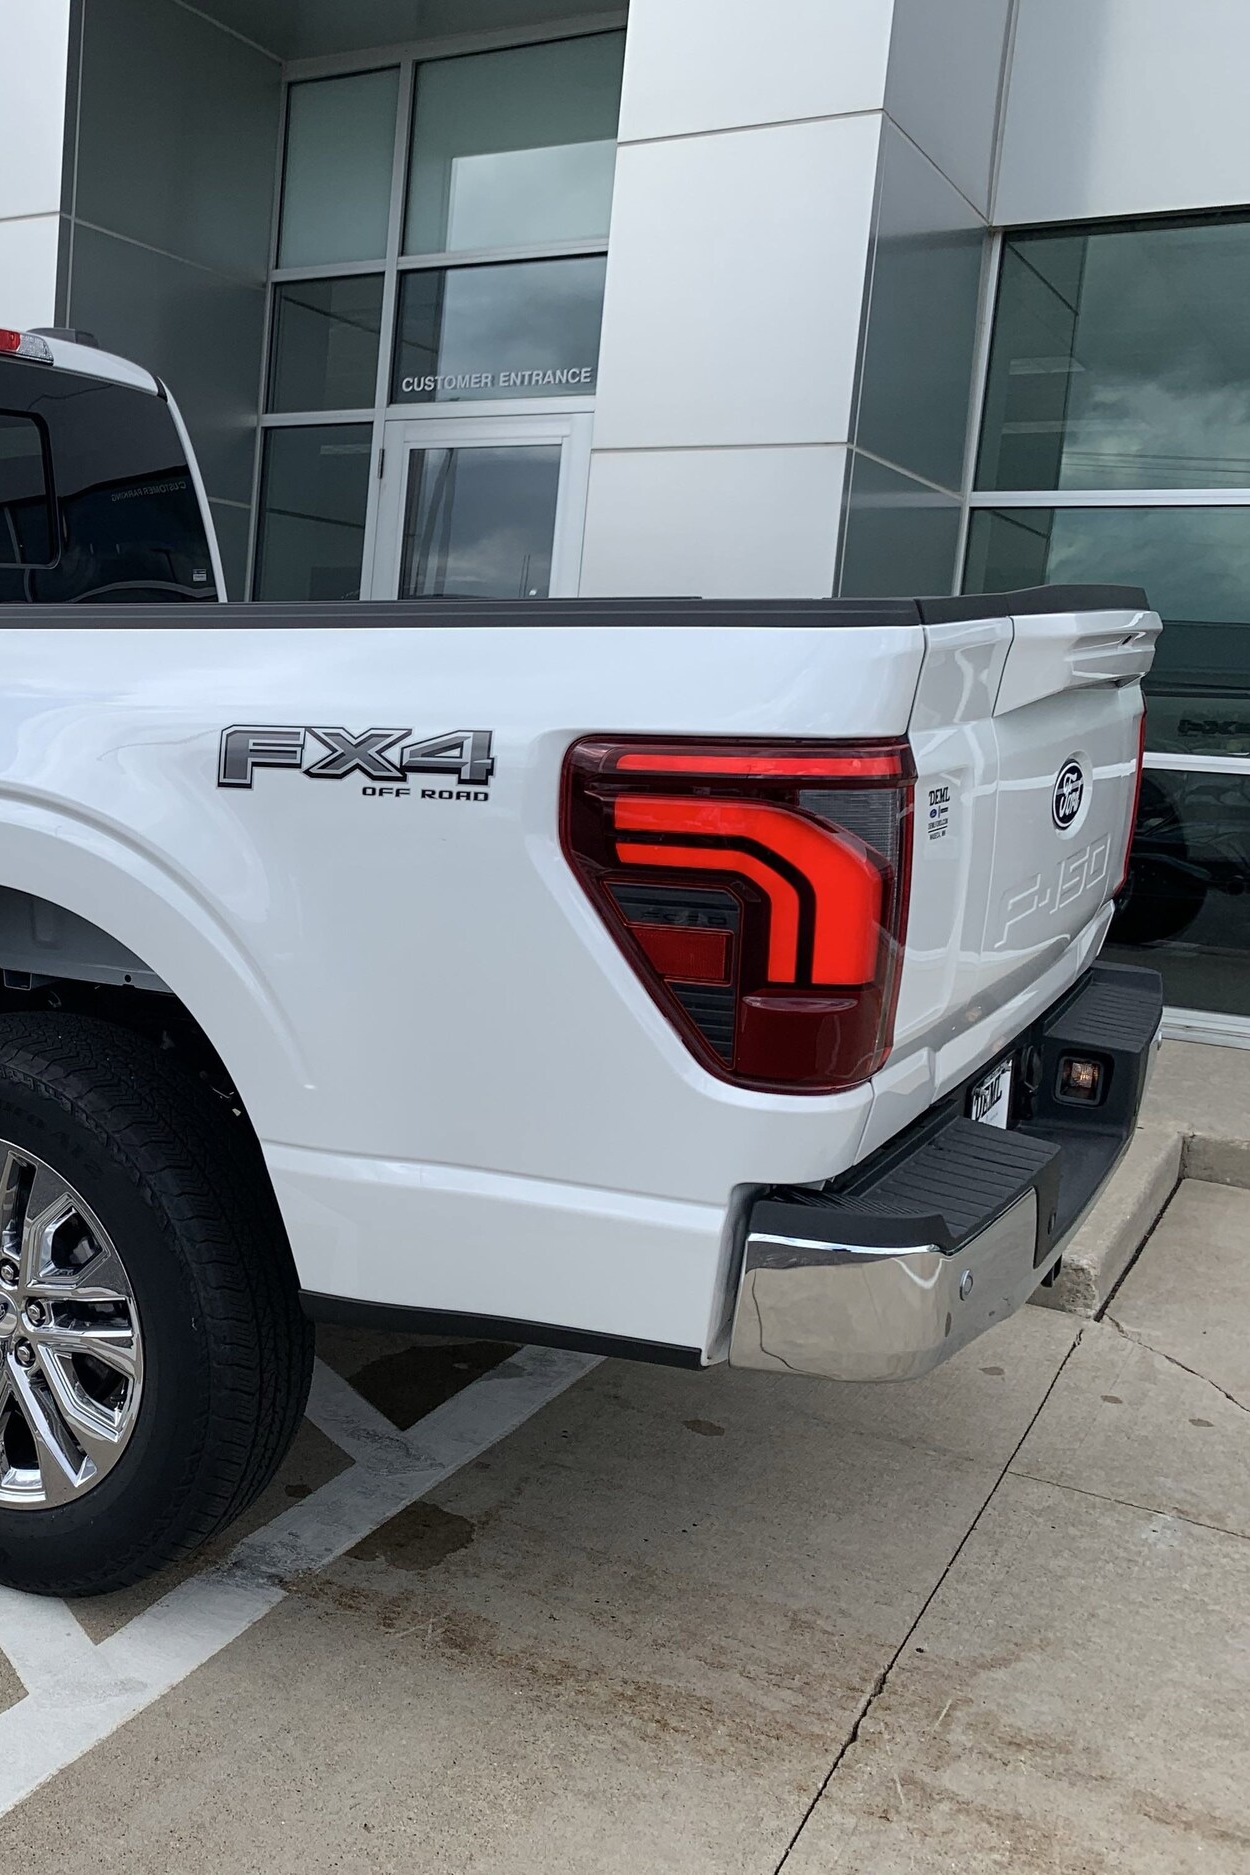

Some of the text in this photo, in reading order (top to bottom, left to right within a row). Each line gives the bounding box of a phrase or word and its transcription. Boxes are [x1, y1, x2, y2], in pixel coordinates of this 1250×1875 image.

[401, 367, 592, 392] CUSTOMER ENTRANCE
[217, 724, 498, 788] FX4
[362, 786, 489, 802] OFF ROAD
[929, 786, 950, 806] DEML
[994, 832, 1112, 949] F-150
